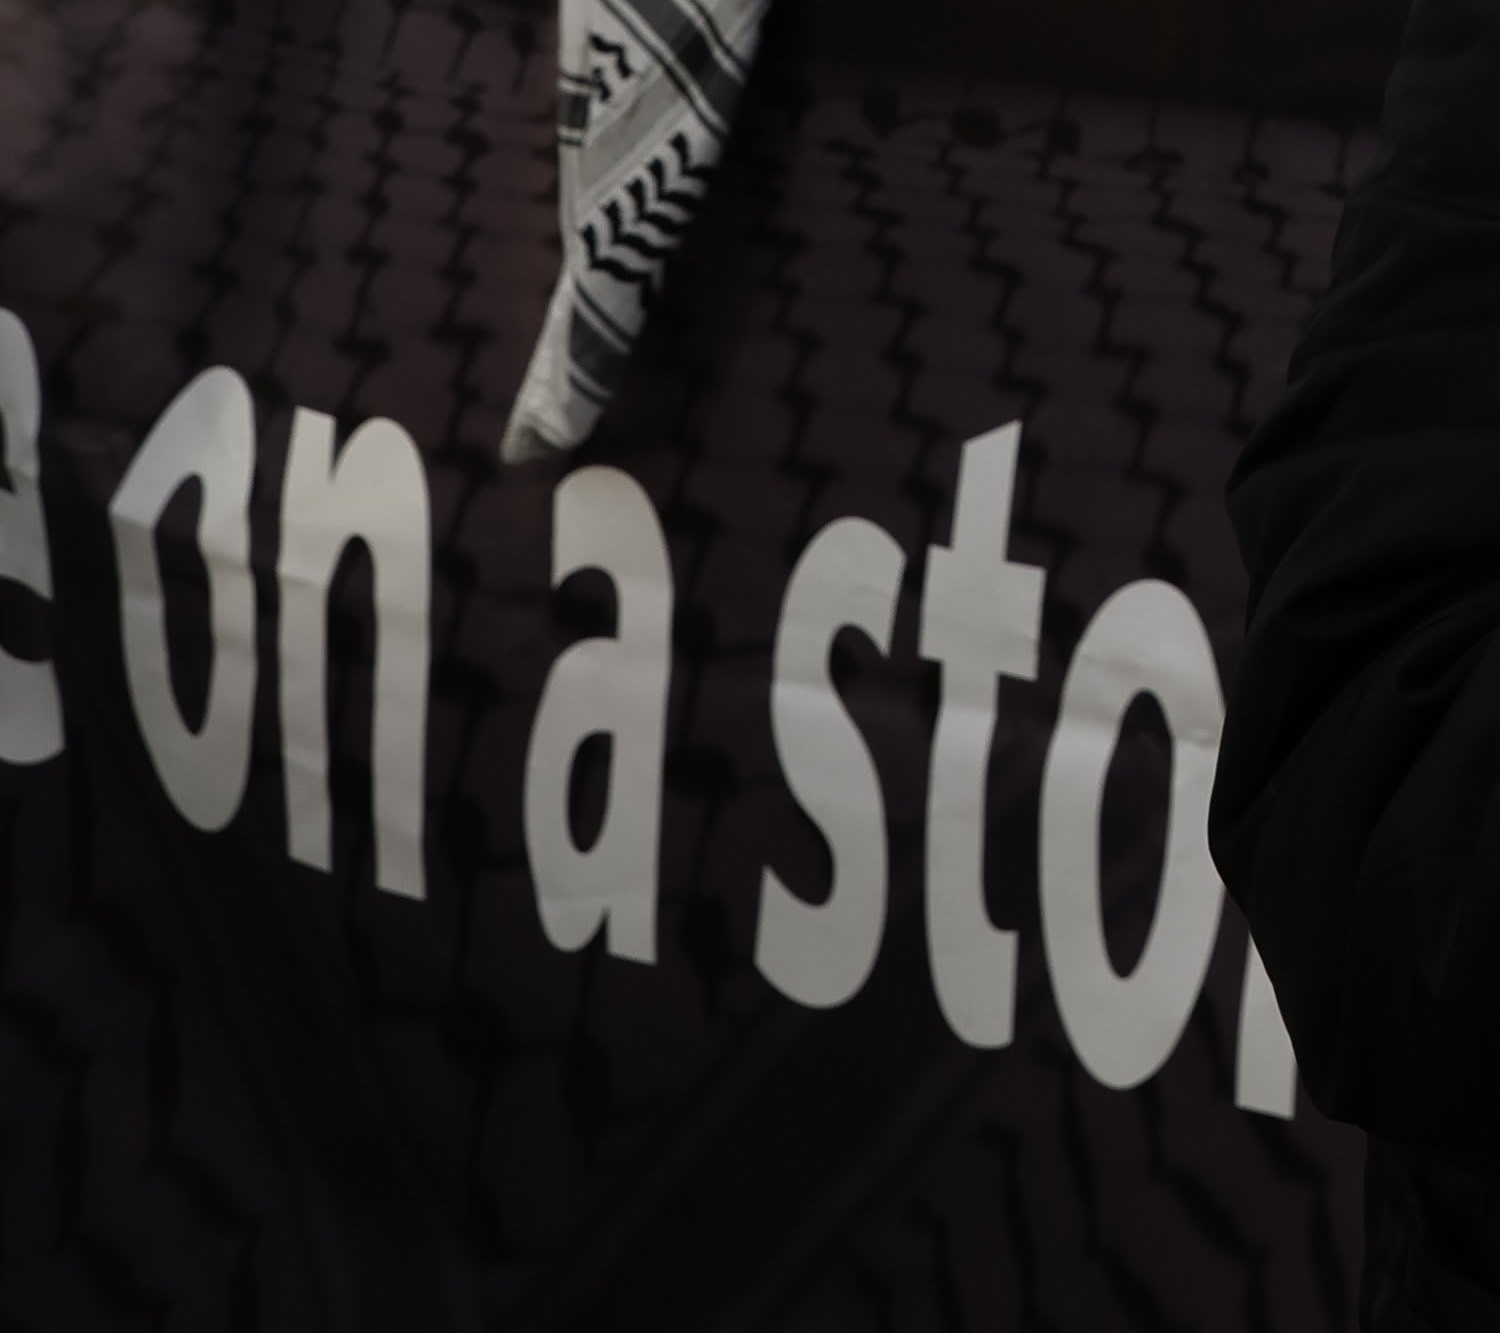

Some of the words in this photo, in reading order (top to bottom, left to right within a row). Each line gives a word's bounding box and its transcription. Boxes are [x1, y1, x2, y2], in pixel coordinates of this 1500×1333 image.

[107, 364, 431, 901] on
[523, 464, 675, 966] a
[754, 419, 1297, 1120] sto
